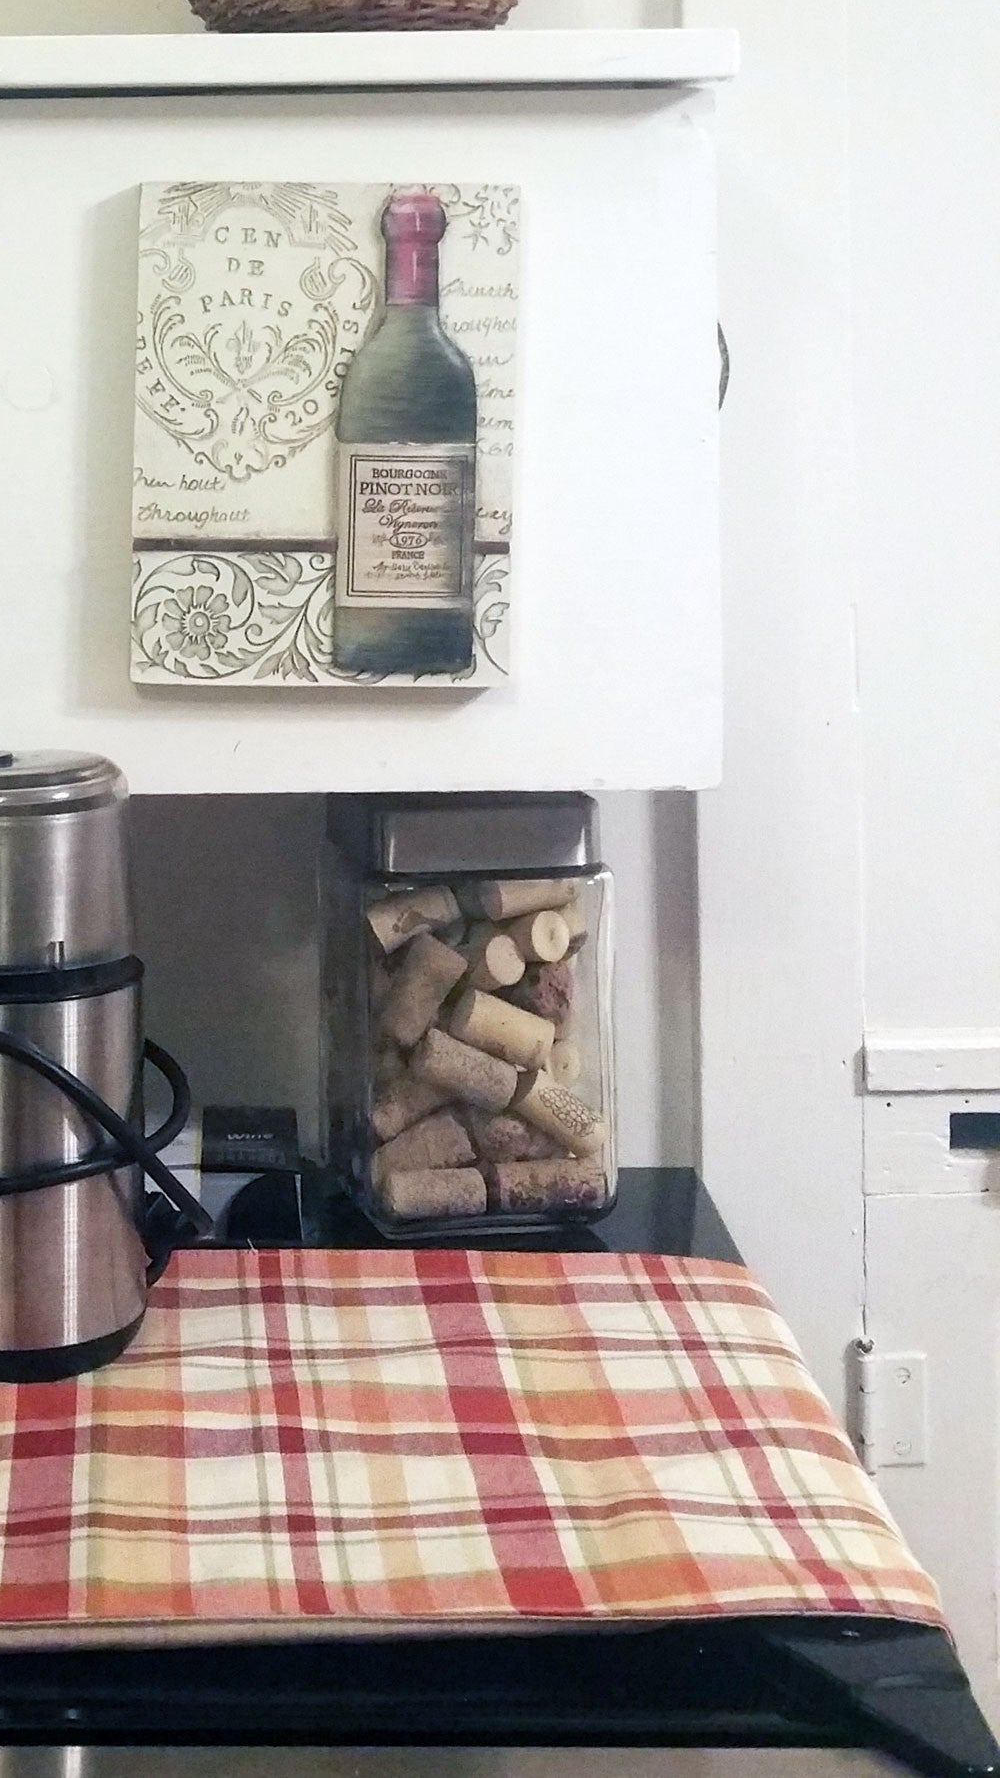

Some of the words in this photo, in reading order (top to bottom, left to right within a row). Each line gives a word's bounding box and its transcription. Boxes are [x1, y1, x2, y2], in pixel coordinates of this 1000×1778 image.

[214, 225, 281, 248] CEN
[227, 257, 264, 276] DE
[200, 288, 292, 318] PARIS
[359, 482, 413, 495] PINOT
[416, 482, 457, 495] NOIR
[393, 535, 423, 545] 1976
[392, 550, 425, 559] FRANCE
